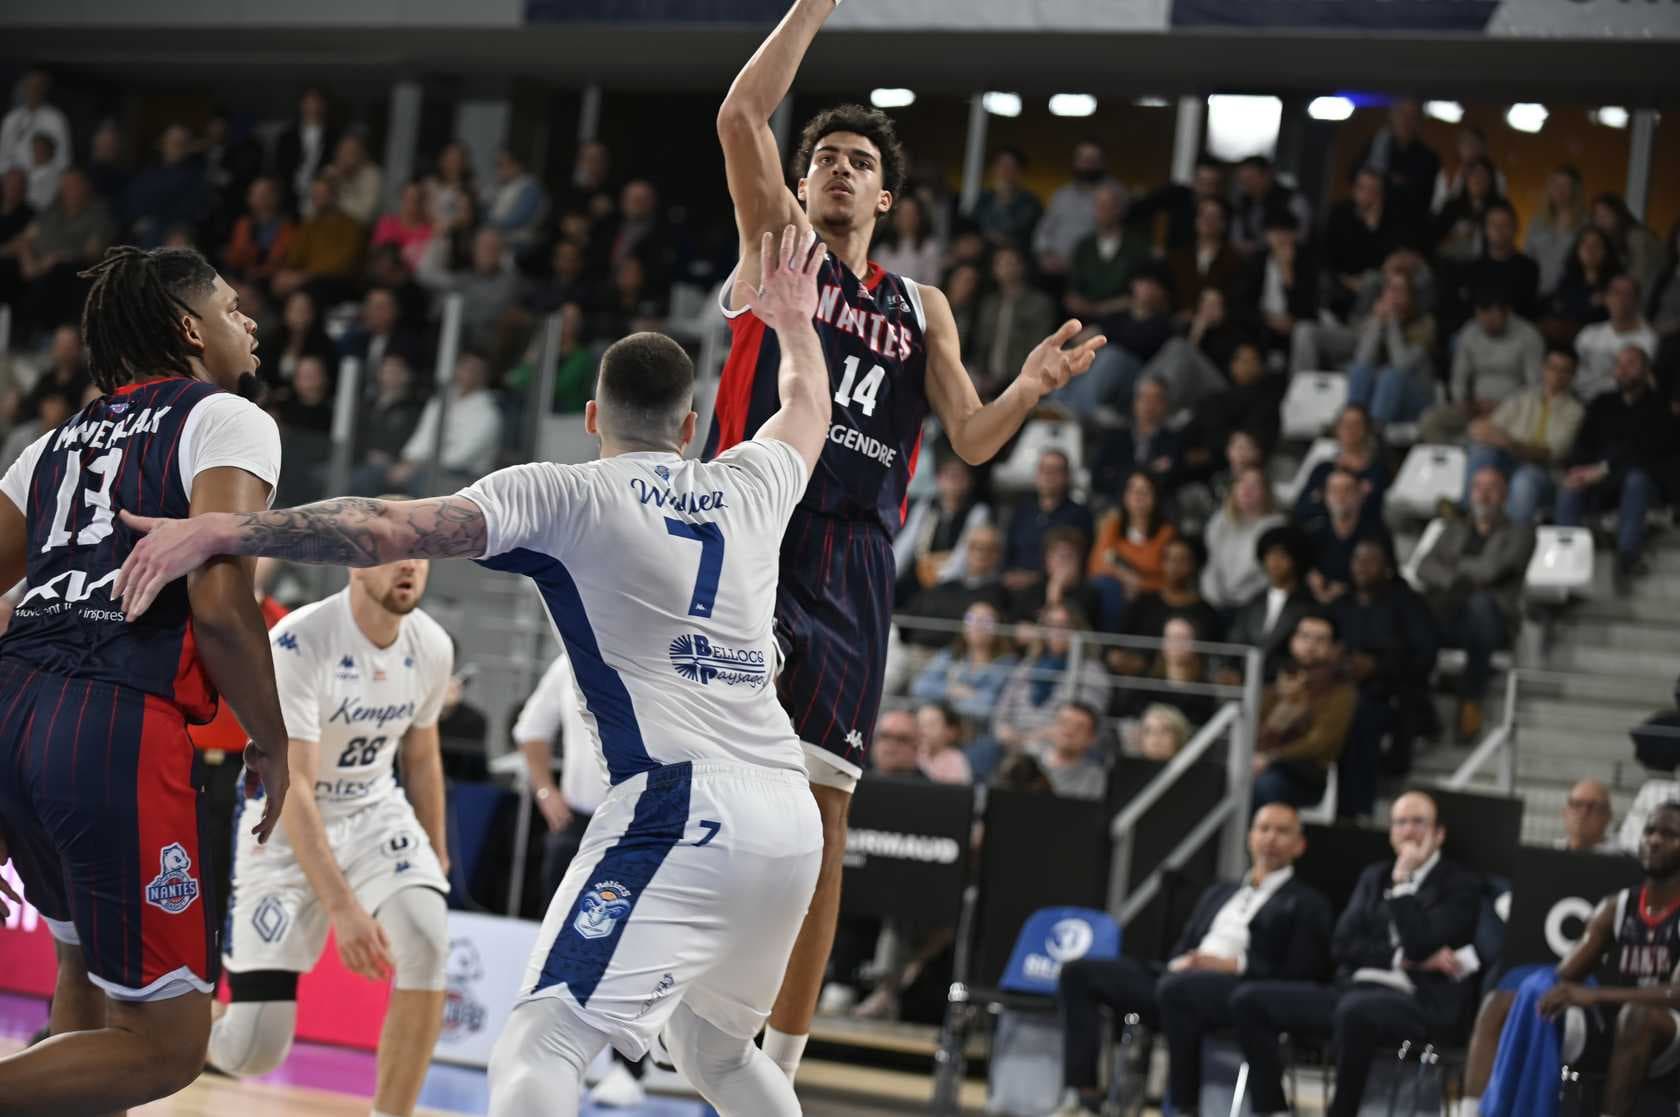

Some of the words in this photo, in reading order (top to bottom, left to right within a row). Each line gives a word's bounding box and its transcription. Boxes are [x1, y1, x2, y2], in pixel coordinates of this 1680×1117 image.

[816, 284, 912, 361] NANTES
[834, 354, 886, 417] 14
[41, 446, 123, 554] 13
[664, 515, 725, 618] 7
[693, 634, 764, 663] BELLOCS
[328, 697, 415, 729] Kemper
[692, 819, 722, 847] 7
[151, 881, 197, 900] NANTES
